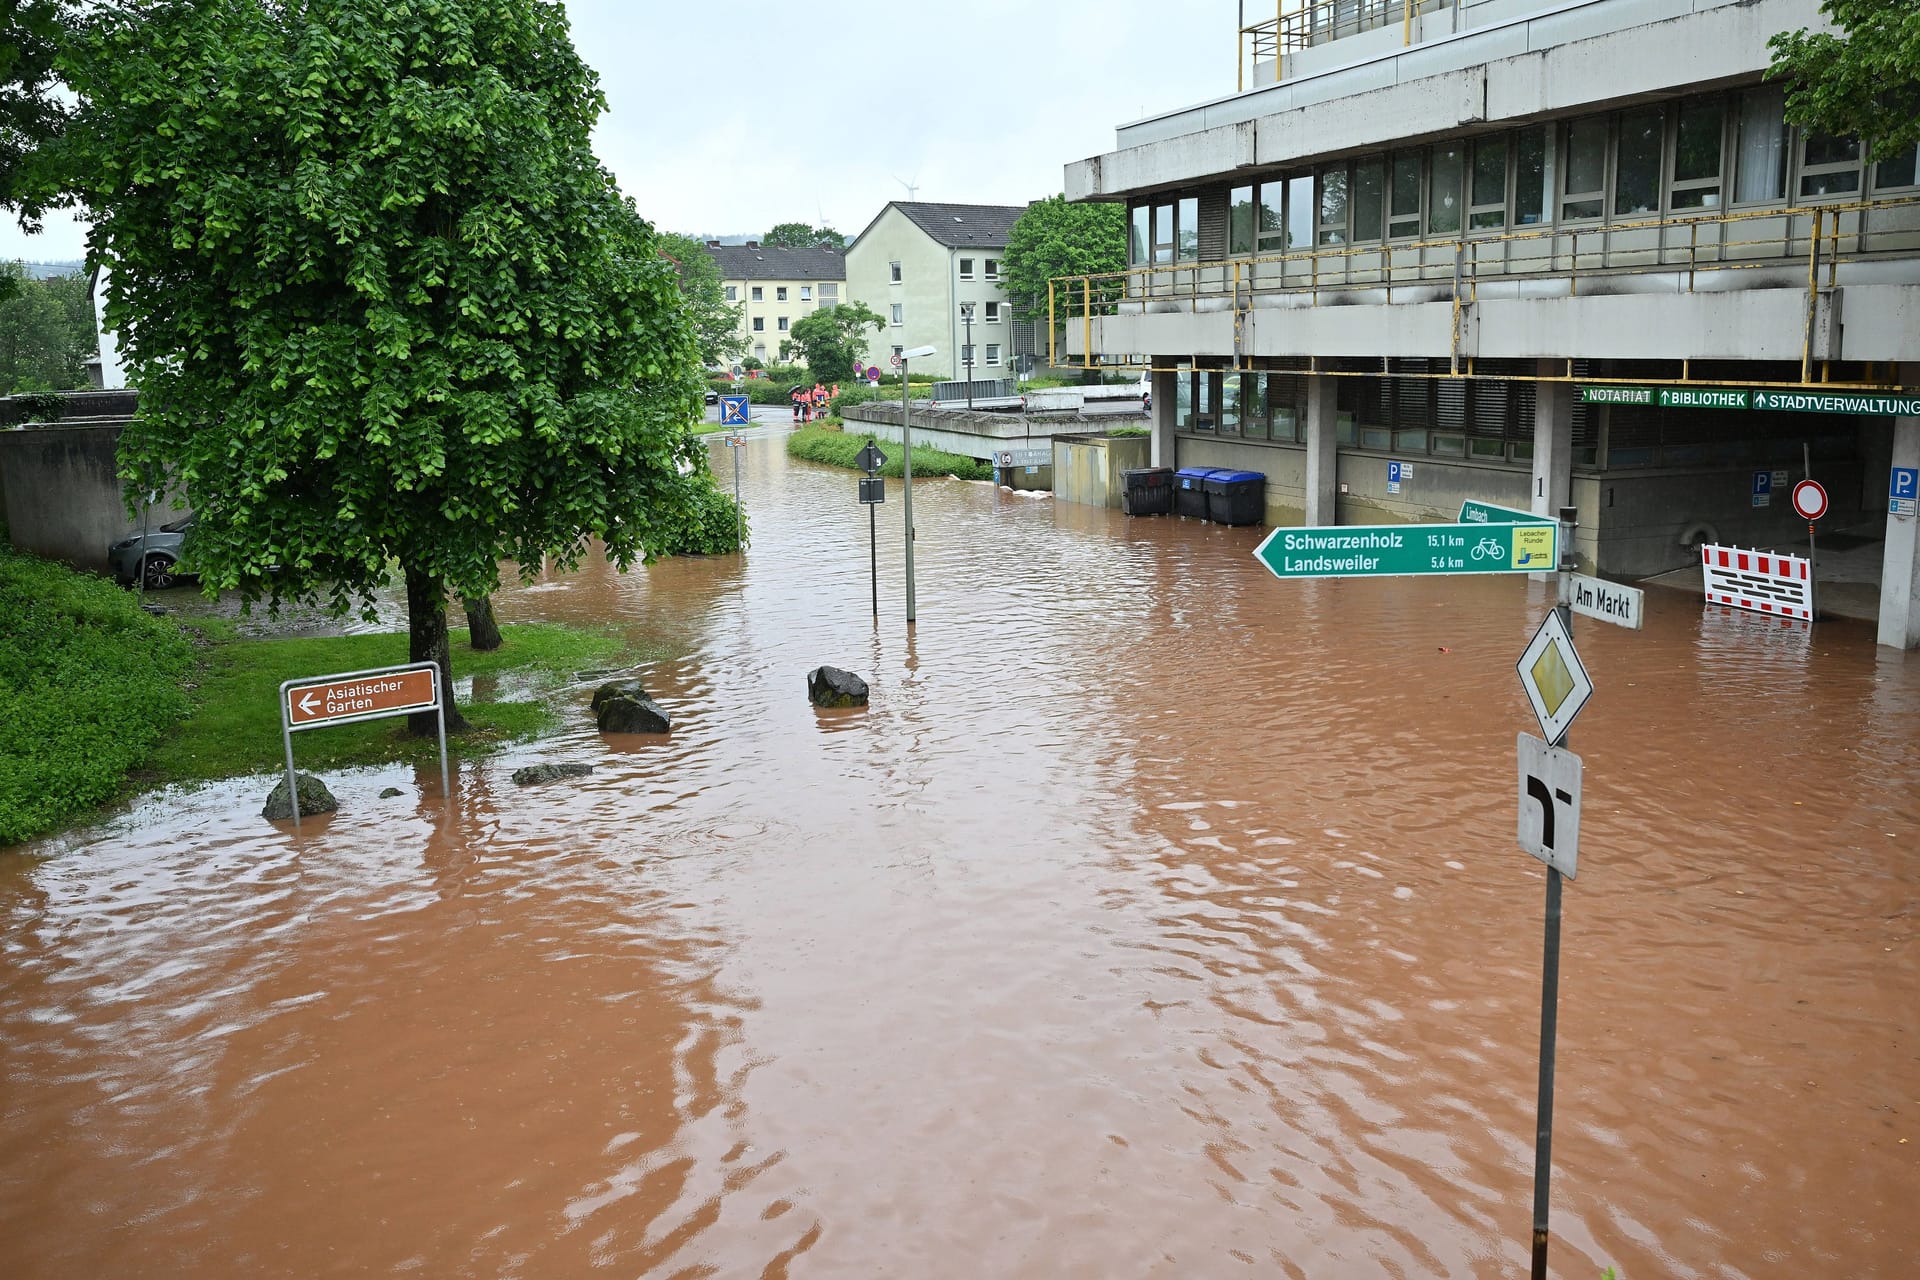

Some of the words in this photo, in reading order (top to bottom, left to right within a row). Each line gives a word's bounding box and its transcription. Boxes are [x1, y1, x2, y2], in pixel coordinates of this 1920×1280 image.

[1589, 388, 1651, 403] NOTARIAT
[1671, 391, 1745, 407] BIBLIOTHEK
[1769, 394, 1920, 415] STADTVERWALTUNG
[1390, 464, 1398, 480] P
[1536, 476, 1544, 497] 1
[1757, 474, 1768, 492] P
[1896, 471, 1912, 494] P
[1466, 505, 1488, 523] Limbach
[1284, 532, 1404, 550] Schwarzenholz
[1427, 534, 1446, 547] 15.1
[1448, 534, 1465, 547] km
[1284, 555, 1379, 571] Landsweiler
[1431, 556, 1445, 569] 5.6
[1447, 555, 1464, 568] km
[1576, 582, 1593, 608] Am
[1596, 587, 1630, 619] Markt
[326, 681, 404, 701] Asiatischer
[326, 698, 373, 714] Garten
